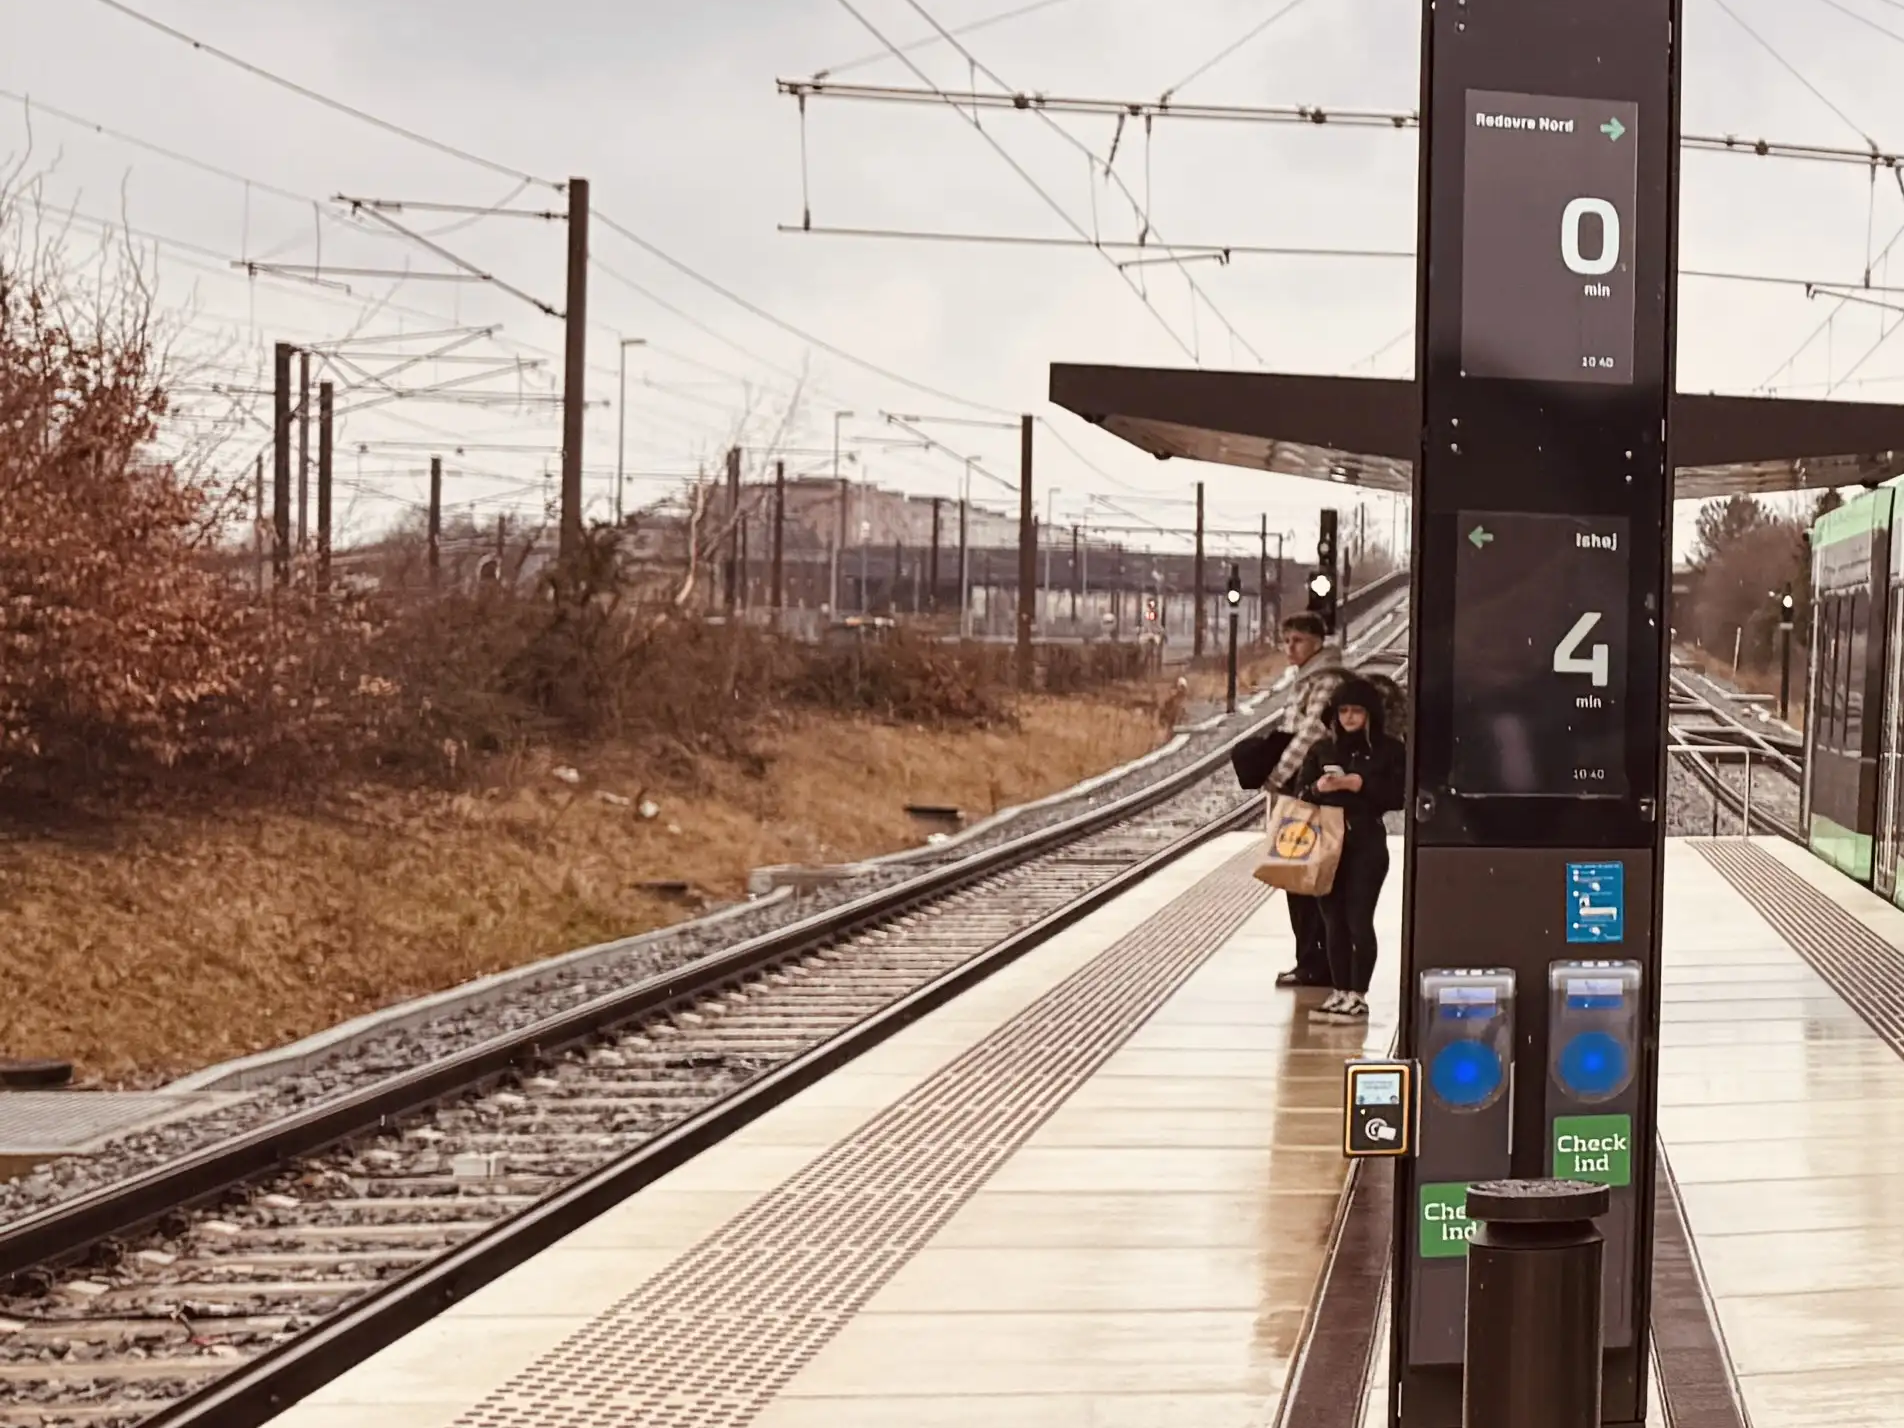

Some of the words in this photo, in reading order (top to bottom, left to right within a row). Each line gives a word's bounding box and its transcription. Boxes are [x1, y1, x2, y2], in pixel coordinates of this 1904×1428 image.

[1539, 117, 1574, 133] Nord
[1561, 197, 1620, 275] 0
[1584, 282, 1611, 297] min
[1553, 612, 1608, 686] 4
[1576, 694, 1602, 708] min
[1557, 1133, 1627, 1153] Check
[1574, 1153, 1609, 1172] Ind
[1424, 1202, 1466, 1221] Che
[1442, 1221, 1477, 1241] Ind
